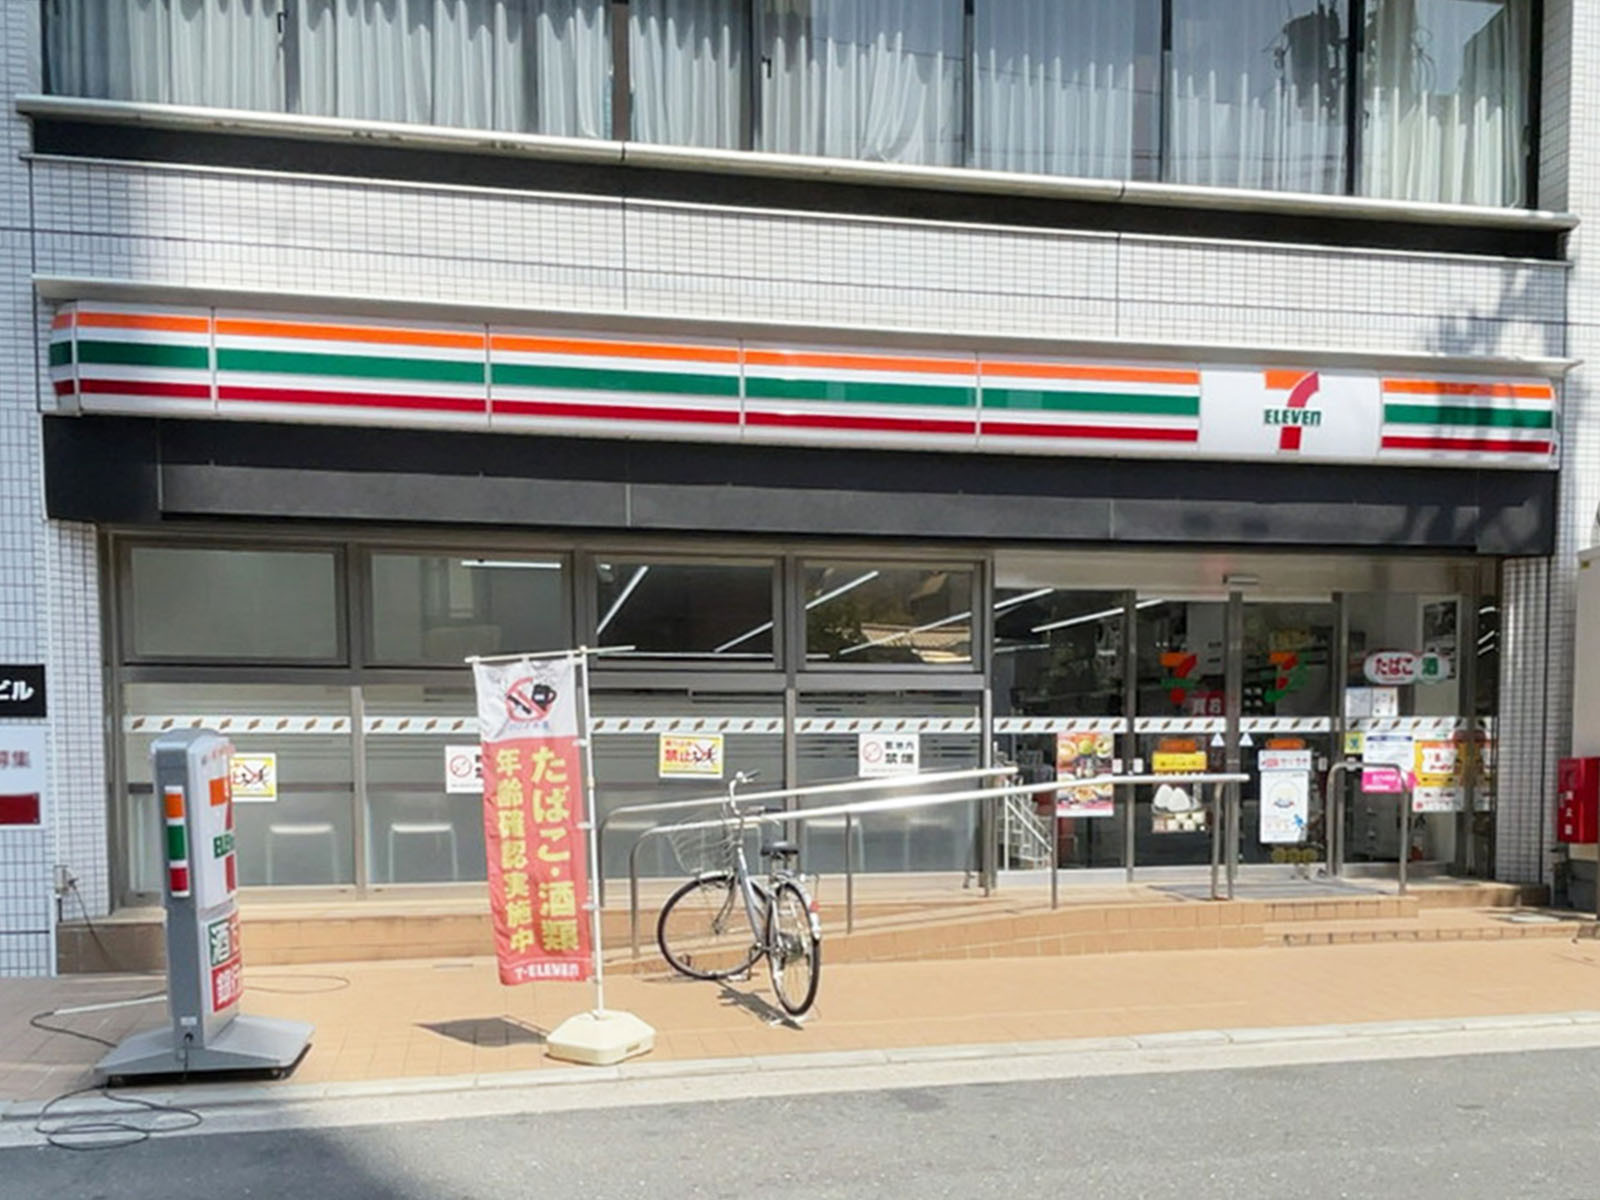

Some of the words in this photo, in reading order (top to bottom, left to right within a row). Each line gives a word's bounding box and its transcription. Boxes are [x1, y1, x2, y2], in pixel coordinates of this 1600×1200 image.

[1375, 657, 1413, 676] たばこ
[885, 753, 914, 764] 禁煙
[496, 748, 534, 953] 年齢確認実施中
[531, 746, 580, 950] たばこ・酒類
